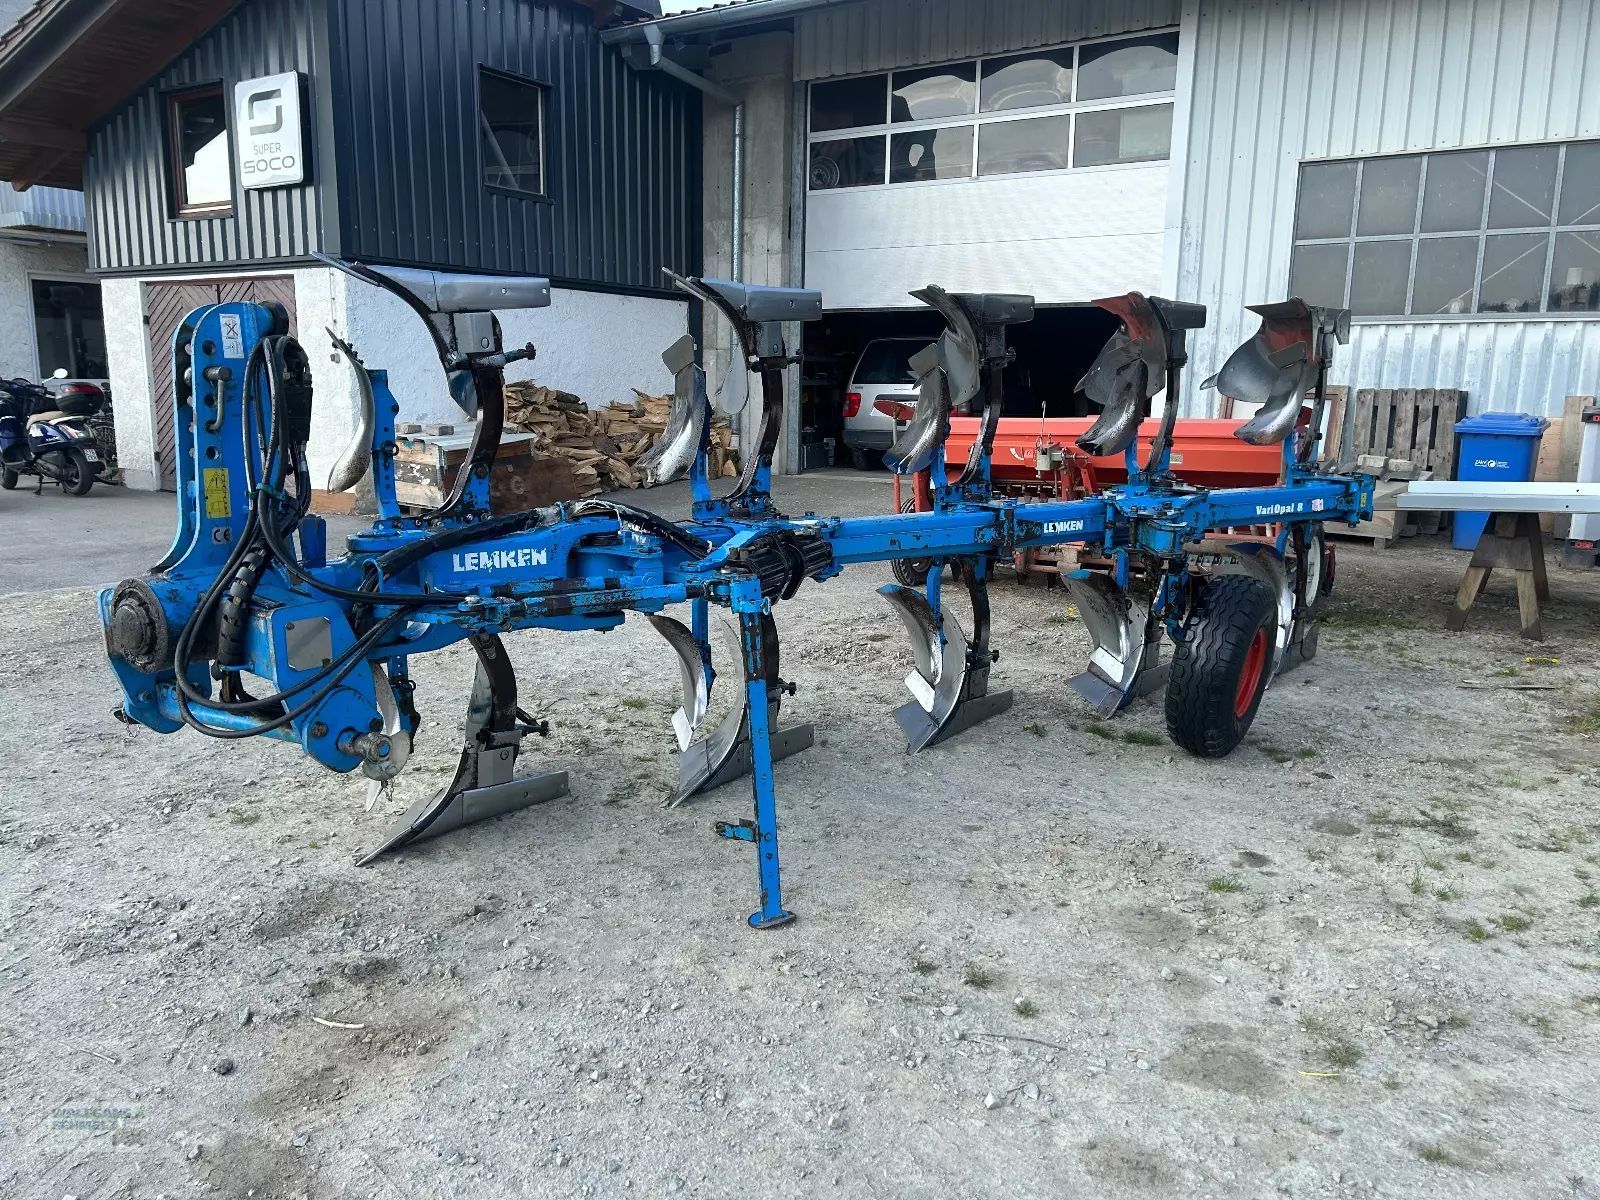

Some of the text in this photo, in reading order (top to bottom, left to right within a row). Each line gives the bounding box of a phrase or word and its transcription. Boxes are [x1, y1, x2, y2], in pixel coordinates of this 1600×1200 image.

[253, 142, 282, 155] SUPER
[243, 155, 295, 174] SOCO
[1256, 502, 1295, 516] VariOpal
[1043, 519, 1084, 534] LEMKEN
[452, 548, 547, 572] LEMKEN
